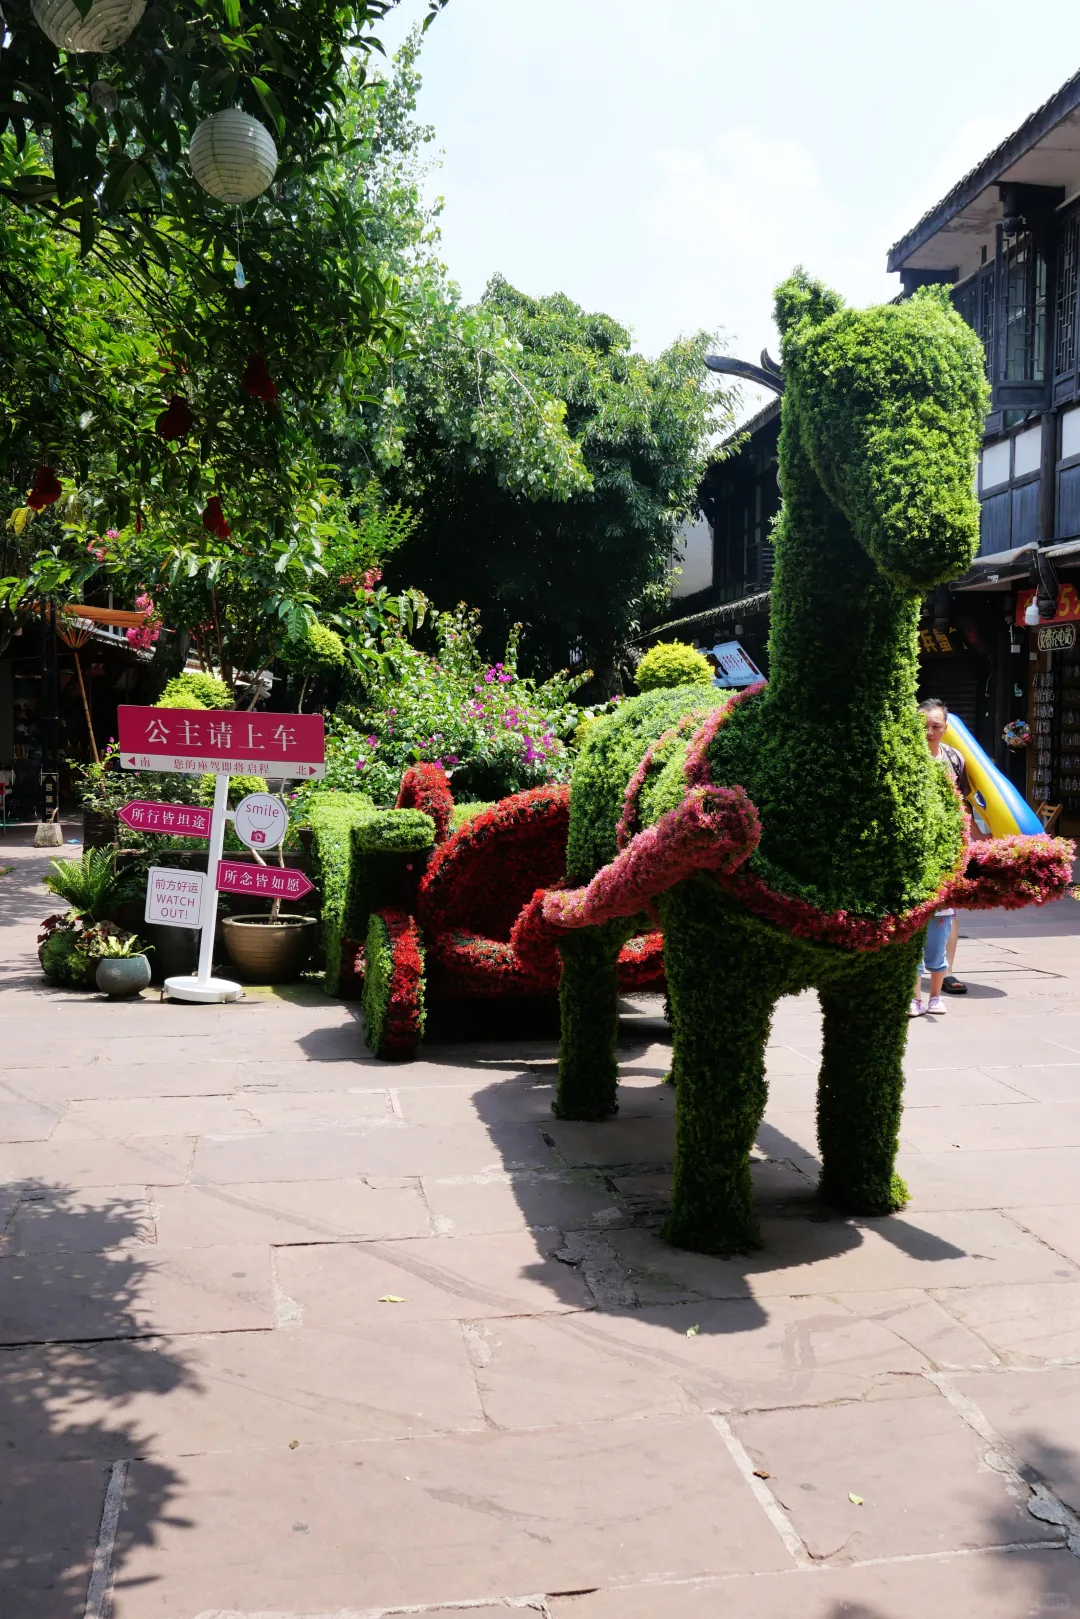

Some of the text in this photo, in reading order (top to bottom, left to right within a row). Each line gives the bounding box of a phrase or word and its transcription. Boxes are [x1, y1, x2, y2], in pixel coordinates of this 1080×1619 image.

[145, 719, 297, 752] 公主请上车
[140, 757, 307, 776] 南 您的座驾即将启程 北
[131, 808, 206, 830] 所行皆坦途
[246, 803, 279, 818] smile
[155, 878, 199, 894] 前方好运
[224, 869, 300, 892] 所念皆如愿
[157, 894, 195, 906] WATCH
[161, 908, 189, 920] OUT!
